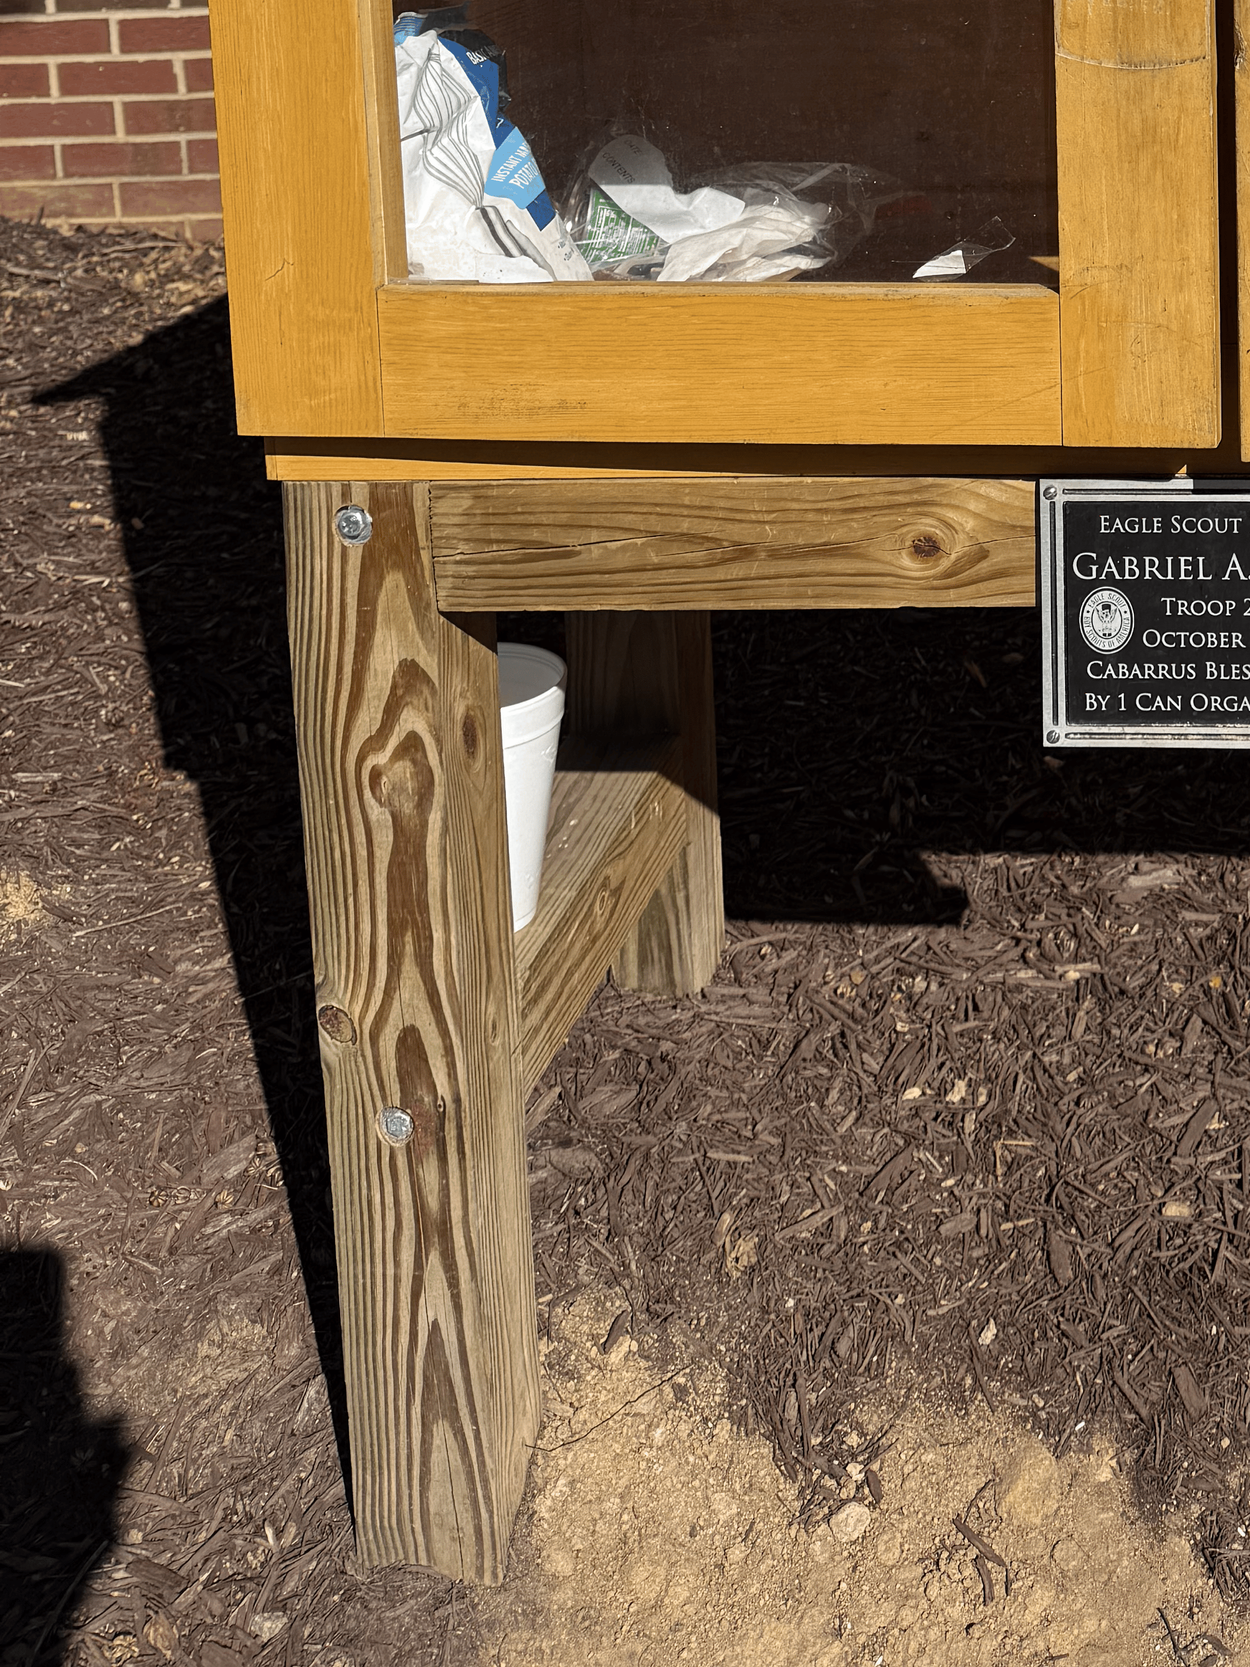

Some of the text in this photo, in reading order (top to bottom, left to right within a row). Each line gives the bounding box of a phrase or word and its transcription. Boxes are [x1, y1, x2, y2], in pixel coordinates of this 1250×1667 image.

[491, 155, 520, 182] INSTANT
[602, 152, 635, 184] CONTENTS
[1099, 515, 1163, 535] EAGLE
[1171, 515, 1242, 535] SCOUT
[1072, 552, 1213, 581] GABRIEL
[1088, 593, 1126, 608] EAGLE SCOUT
[1161, 598, 1237, 617] TROOP
[1086, 629, 1106, 648] SCOUTS
[1116, 617, 1130, 644] AMERICA
[1142, 629, 1246, 649] OCTOBER
[1087, 660, 1197, 680] CABARRUS
[1085, 693, 1111, 711] BY
[1117, 694, 1127, 711] 1
[1135, 694, 1182, 712] CAN
